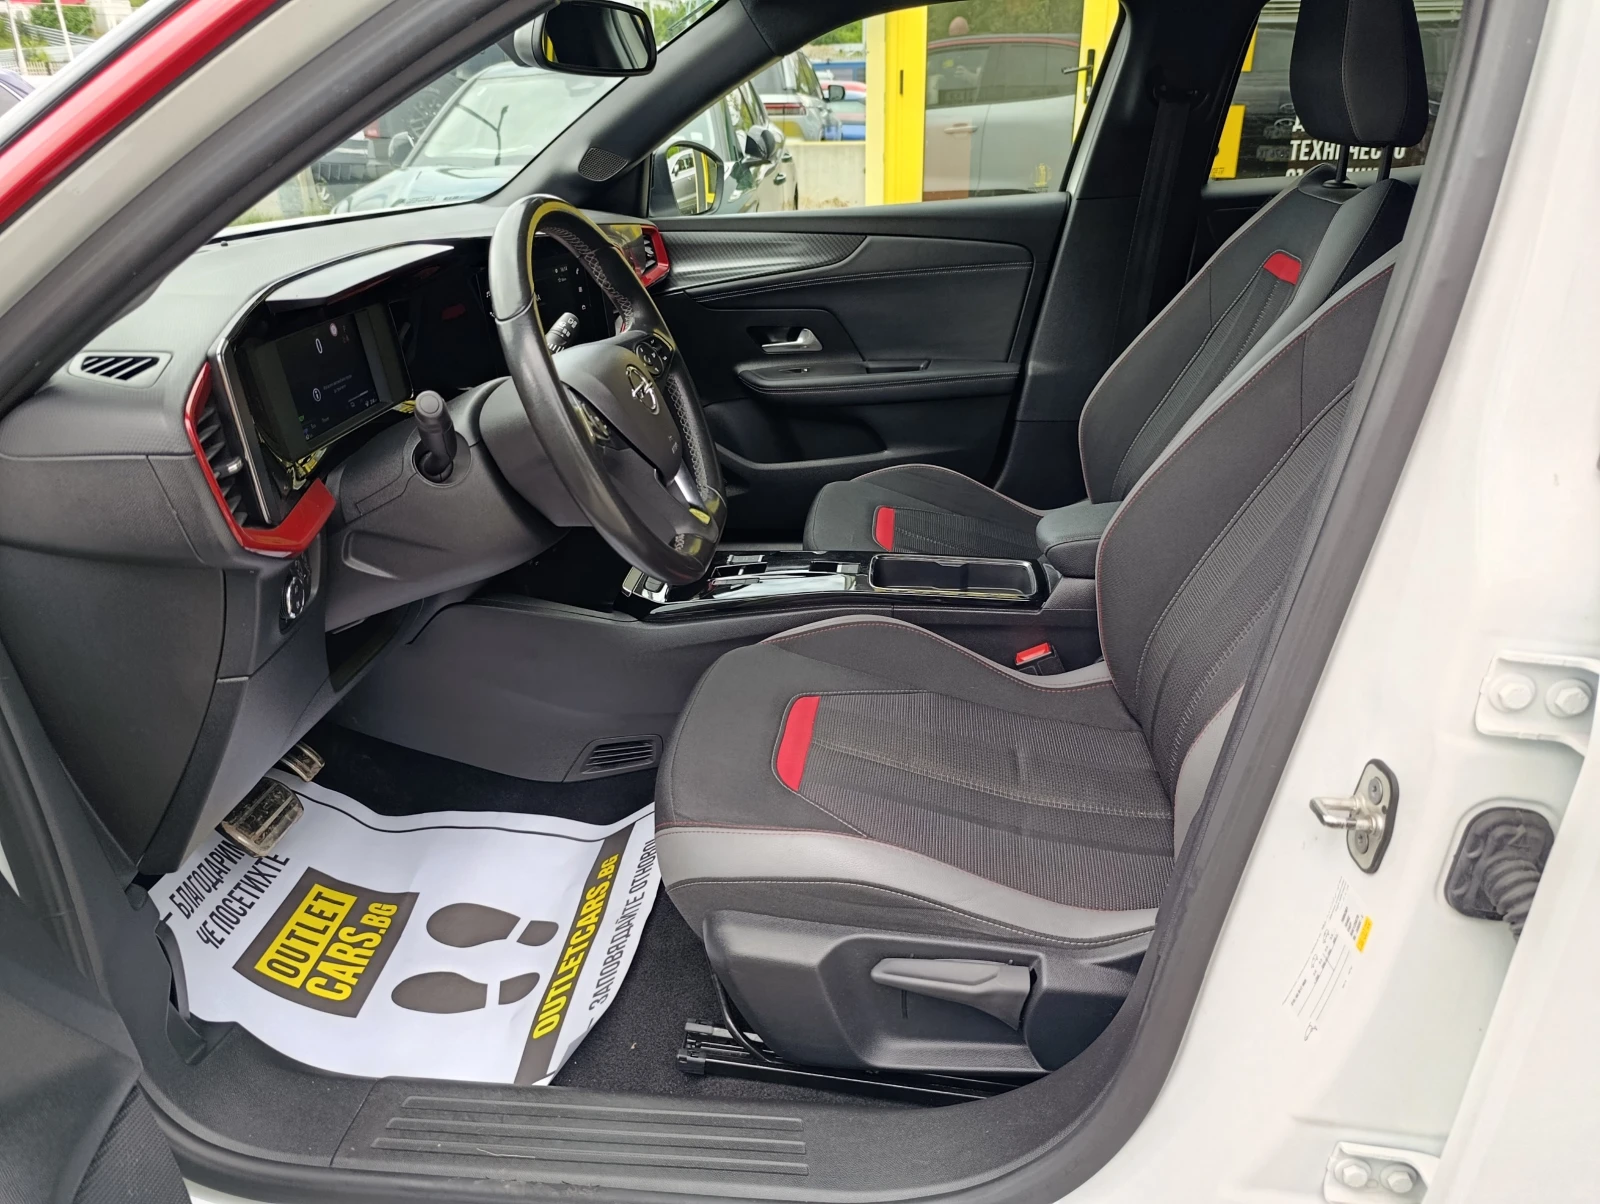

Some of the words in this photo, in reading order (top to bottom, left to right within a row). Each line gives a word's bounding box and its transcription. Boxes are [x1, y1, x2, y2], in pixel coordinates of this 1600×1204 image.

[1290, 139, 1407, 161] ТЕХНЧЕСО
[196, 920, 226, 949] ЧЕ
[209, 852, 291, 936] ПОСЕТИХТЕ
[265, 890, 348, 980] OUTLET
[305, 902, 399, 1002] CARS.BG
[532, 853, 621, 1040] OUTLETCARS.BG
[588, 891, 645, 1011] ЗАПОВЯДАЙТЕ
